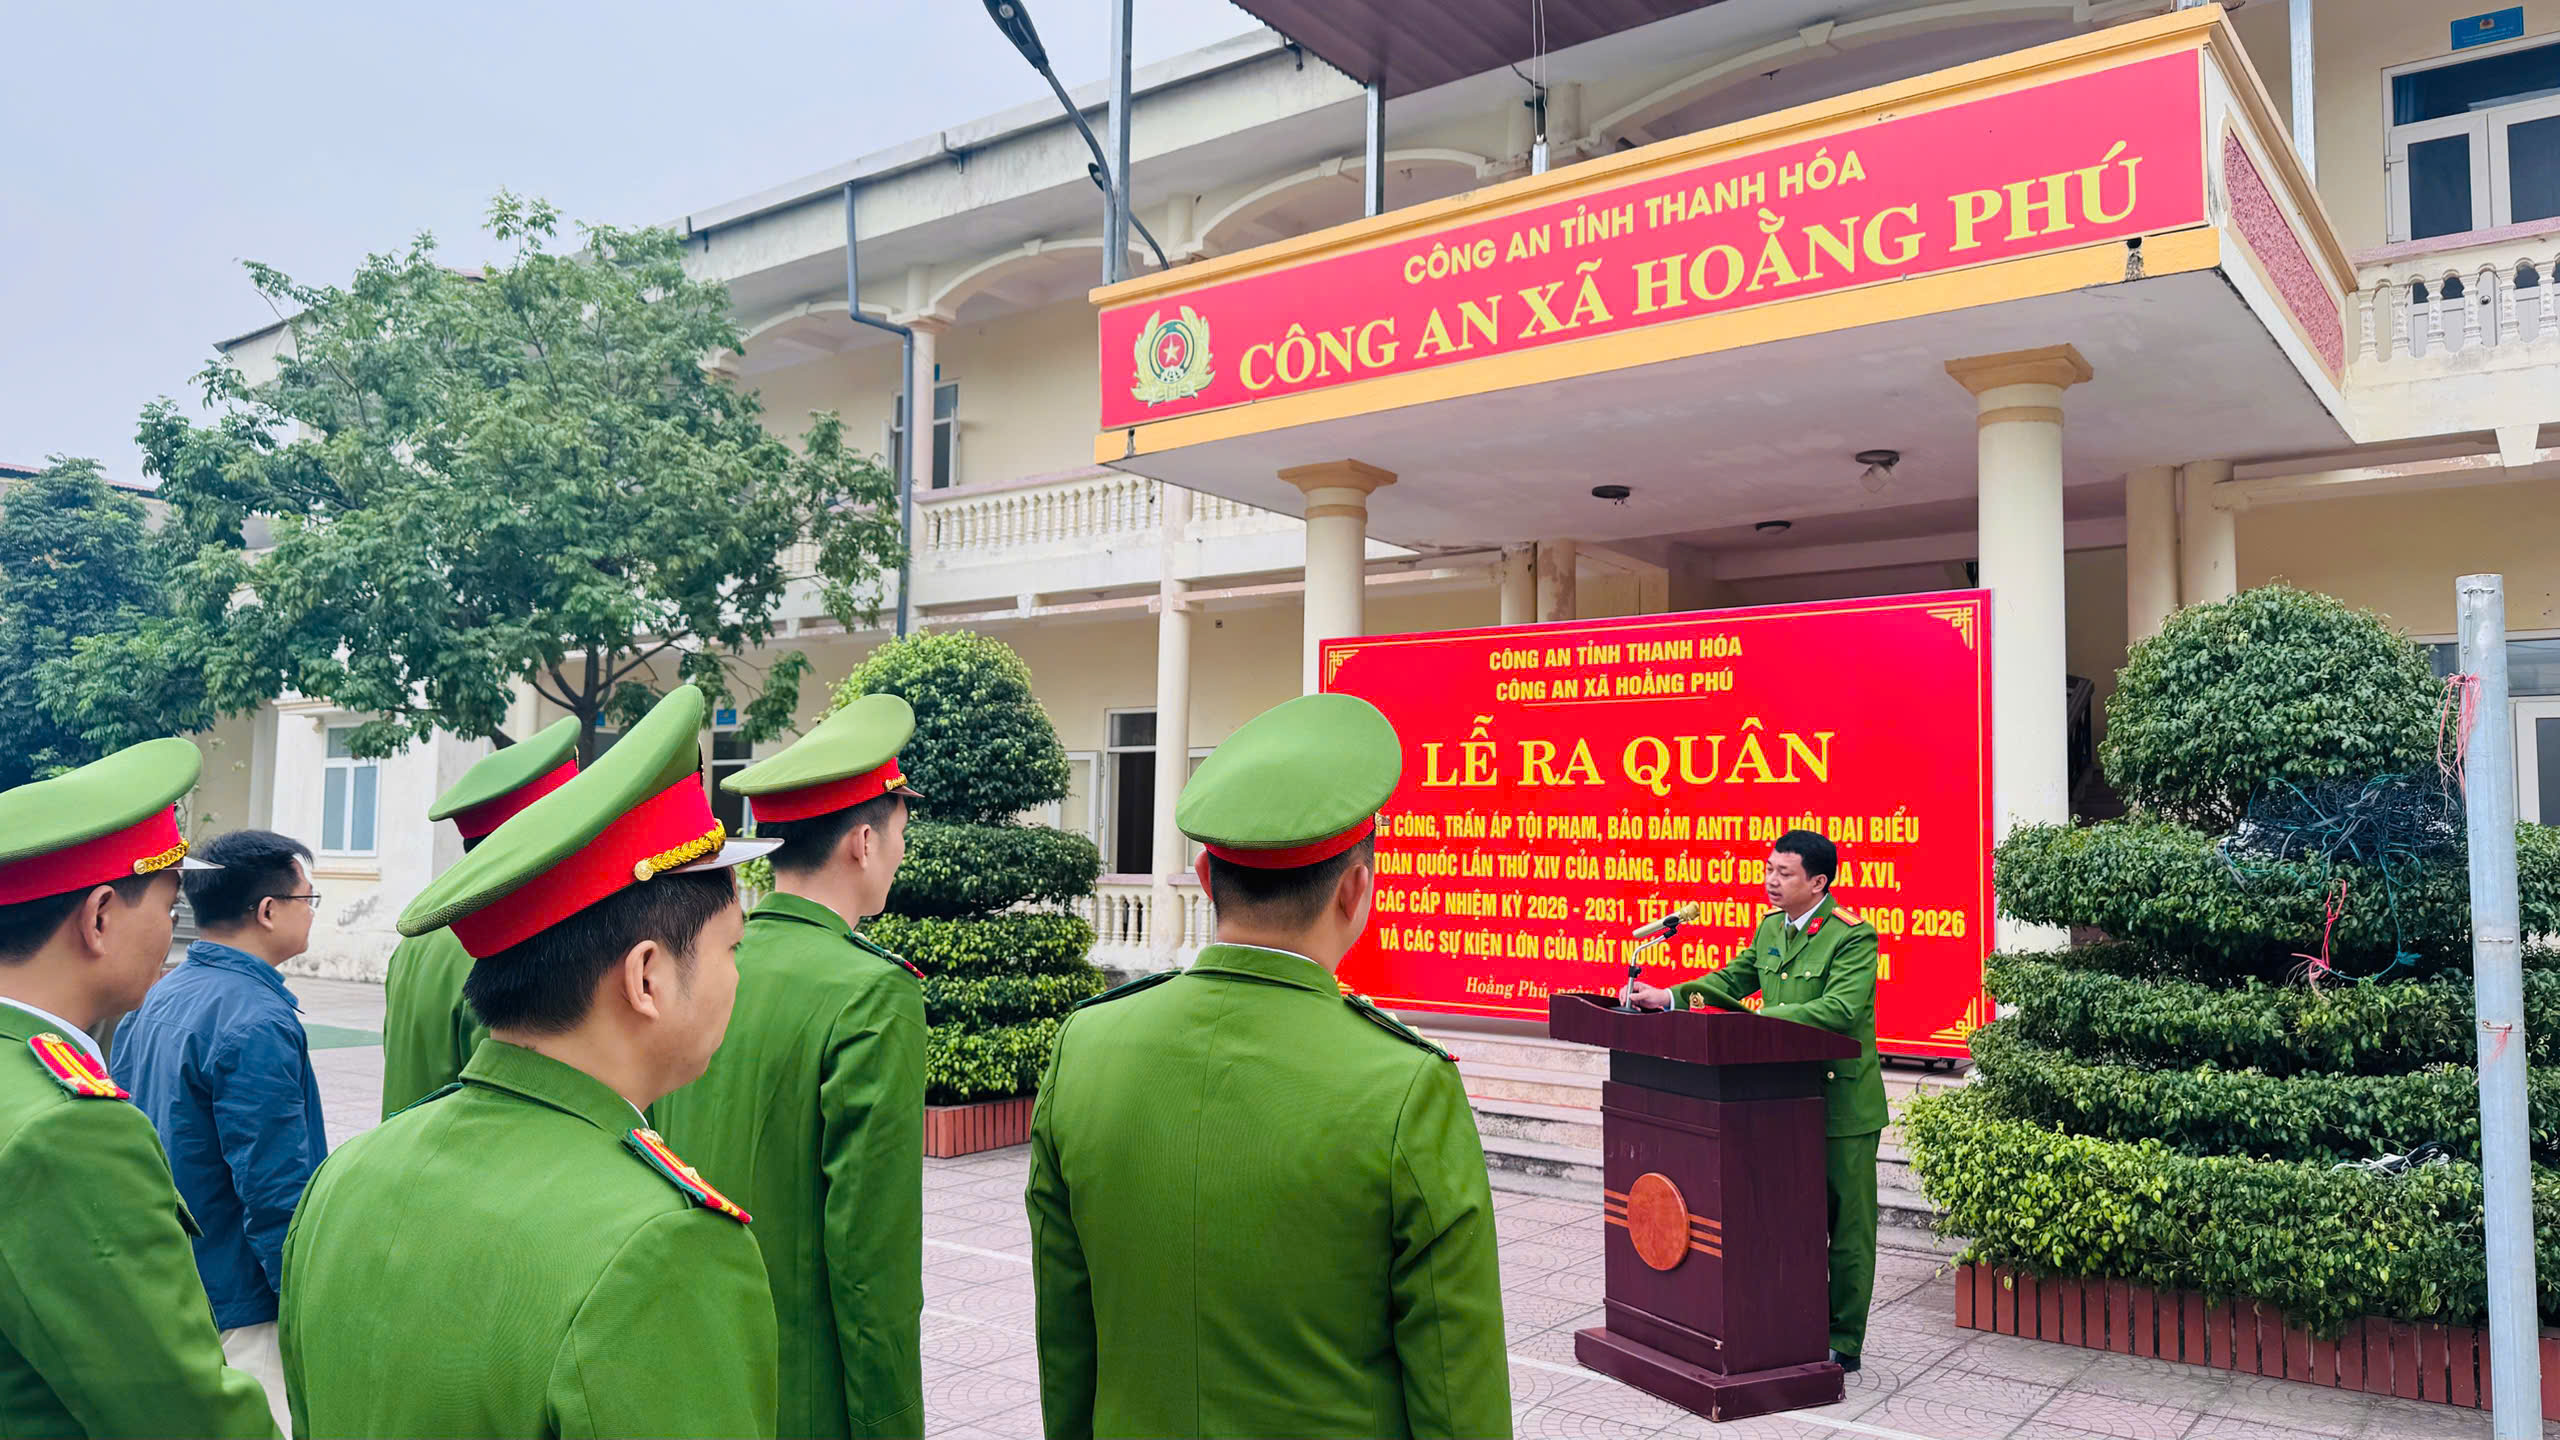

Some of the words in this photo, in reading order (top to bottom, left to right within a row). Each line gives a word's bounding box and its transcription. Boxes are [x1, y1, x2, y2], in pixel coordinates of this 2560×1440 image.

[1403, 238, 1497, 285] CÔNG
[1505, 223, 1551, 263] AN
[1559, 203, 1634, 249] TỈNH
[1643, 170, 1766, 229] THANH
[1778, 146, 1867, 199] HÓA
[1239, 316, 1401, 391] CÔNG
[1413, 294, 1503, 360] AN
[1517, 257, 1614, 339] XÃ
[1631, 202, 1927, 316] HOẰNG
[1947, 139, 2144, 253] PHÚ
[1489, 647, 1539, 671] CÔNG
[1544, 647, 1571, 668] AN
[1576, 639, 1621, 666] TỈNH
[1626, 639, 1693, 663] THANH
[1699, 633, 1743, 659] HÓA
[1496, 678, 1546, 701] CÔNG
[1551, 679, 1578, 699] AN
[1583, 674, 1610, 697] XÃ
[1615, 668, 1685, 696] HOẰNG
[1691, 666, 1733, 693] PHÚ
[1421, 715, 1498, 787] LỄ
[1517, 738, 1605, 786] RA
[1623, 717, 1835, 797] QUÂN
[1394, 810, 1440, 840] CÔNG,
[1444, 808, 1486, 838] TRẤN
[1489, 810, 1513, 839] ÁP
[1516, 810, 1542, 844] TỘI
[1547, 815, 1602, 845] PHẠM,
[1607, 807, 1643, 840] BẢO
[1647, 807, 1690, 841] ĐẢM
[1695, 815, 1744, 841] ANTT
[1748, 816, 1783, 847] ĐẠI
[1827, 816, 1863, 848] ĐẠI
[1870, 805, 1919, 843] BIỂU
[1374, 848, 1413, 875] TOÀN
[1416, 846, 1458, 878] QUỐC
[1462, 847, 1493, 877] LẦN
[1497, 850, 1531, 879] THỨ
[1533, 855, 1561, 879] XIV
[1565, 848, 1600, 881] CỦA
[1604, 849, 1659, 885] ĐẢNG,
[1664, 849, 1702, 883] BẦU
[1707, 850, 1736, 884] CỬ
[1859, 861, 1901, 892] XVI,
[1375, 885, 1406, 913] CÁC
[1409, 884, 1441, 914] CẤP
[1445, 888, 1497, 920] NHIỆM
[1501, 889, 1523, 918] KỲ
[1527, 895, 1568, 920] 2026
[1584, 897, 1633, 925] 2031,
[1637, 890, 1669, 923] TẾT
[1911, 909, 1966, 938] 2026
[1380, 923, 1400, 950] VÀ
[1403, 924, 1435, 953] CÁC
[1439, 928, 1462, 959] SỰ
[1464, 927, 1502, 961] KIỆN
[1506, 929, 1539, 959] LỚN
[1543, 929, 1579, 961] CỦA
[1582, 930, 1617, 963] ĐẤT
[1681, 938, 1720, 969] CÁC
